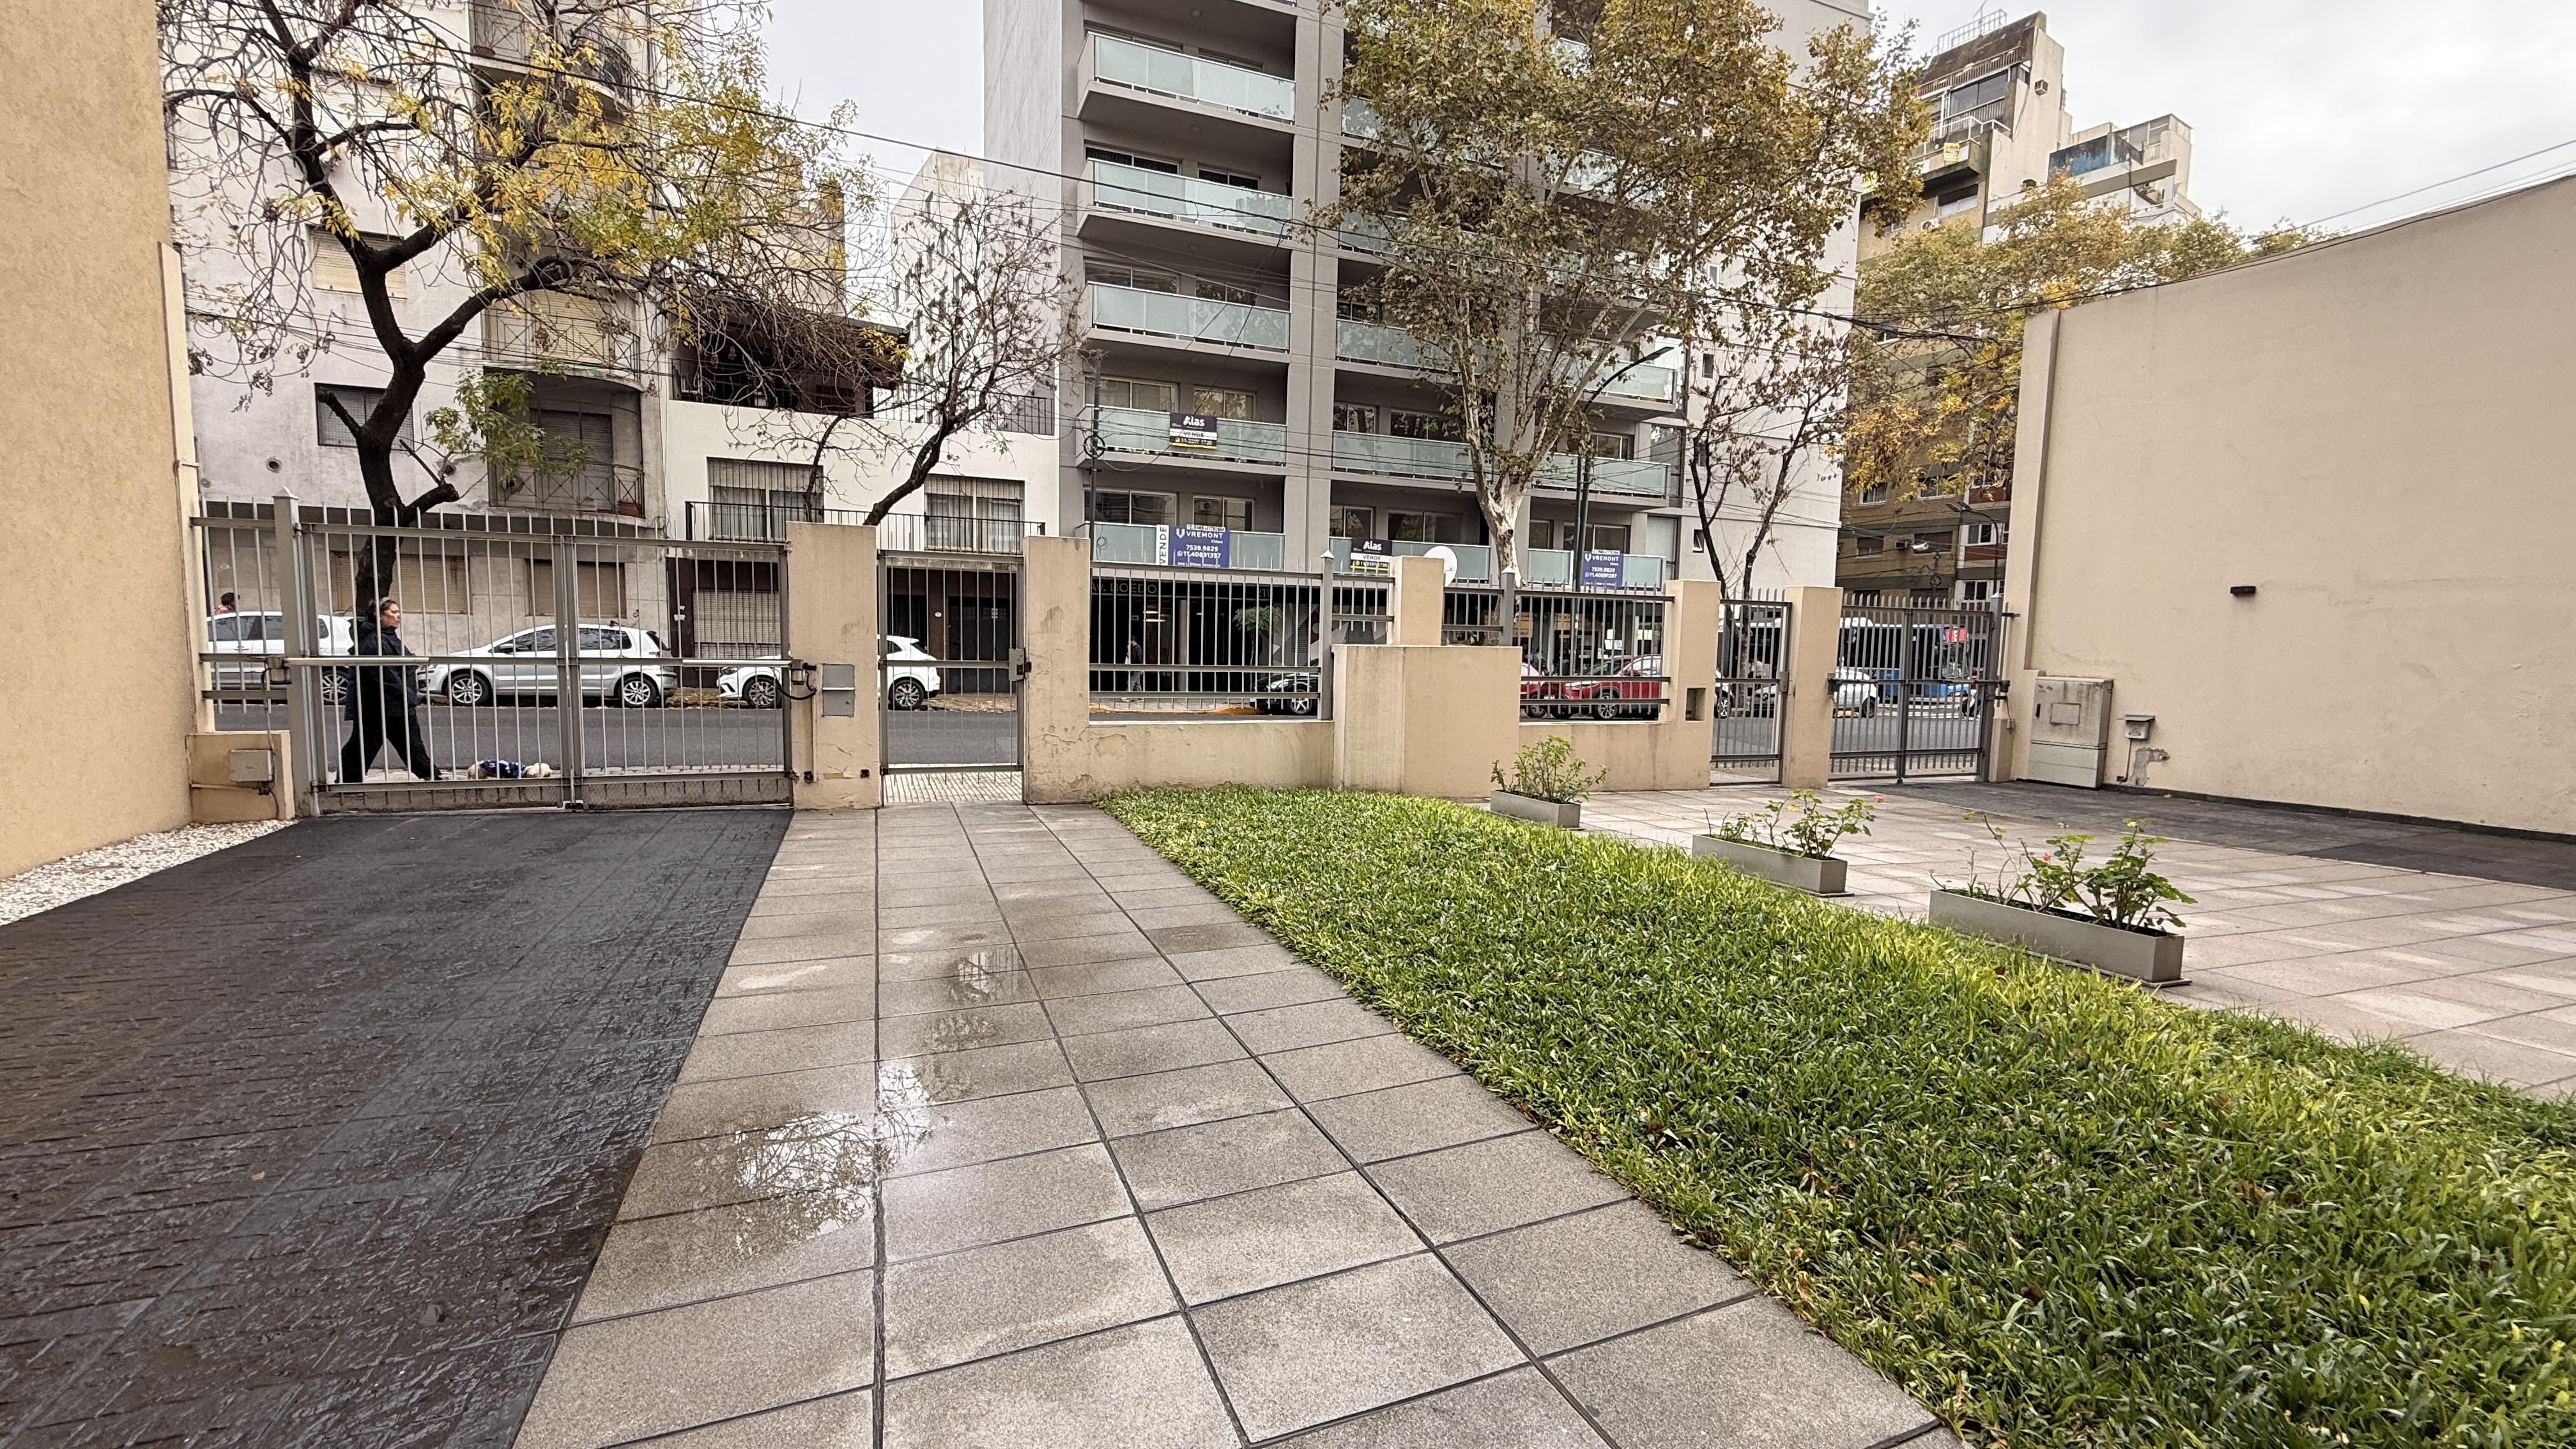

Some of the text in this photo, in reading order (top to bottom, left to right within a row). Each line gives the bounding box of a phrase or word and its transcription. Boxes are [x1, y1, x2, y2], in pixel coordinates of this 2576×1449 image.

[1183, 415, 1205, 427] Alas
[1363, 540, 1382, 551] Alas
[1110, 582, 1156, 594] BOEDO
